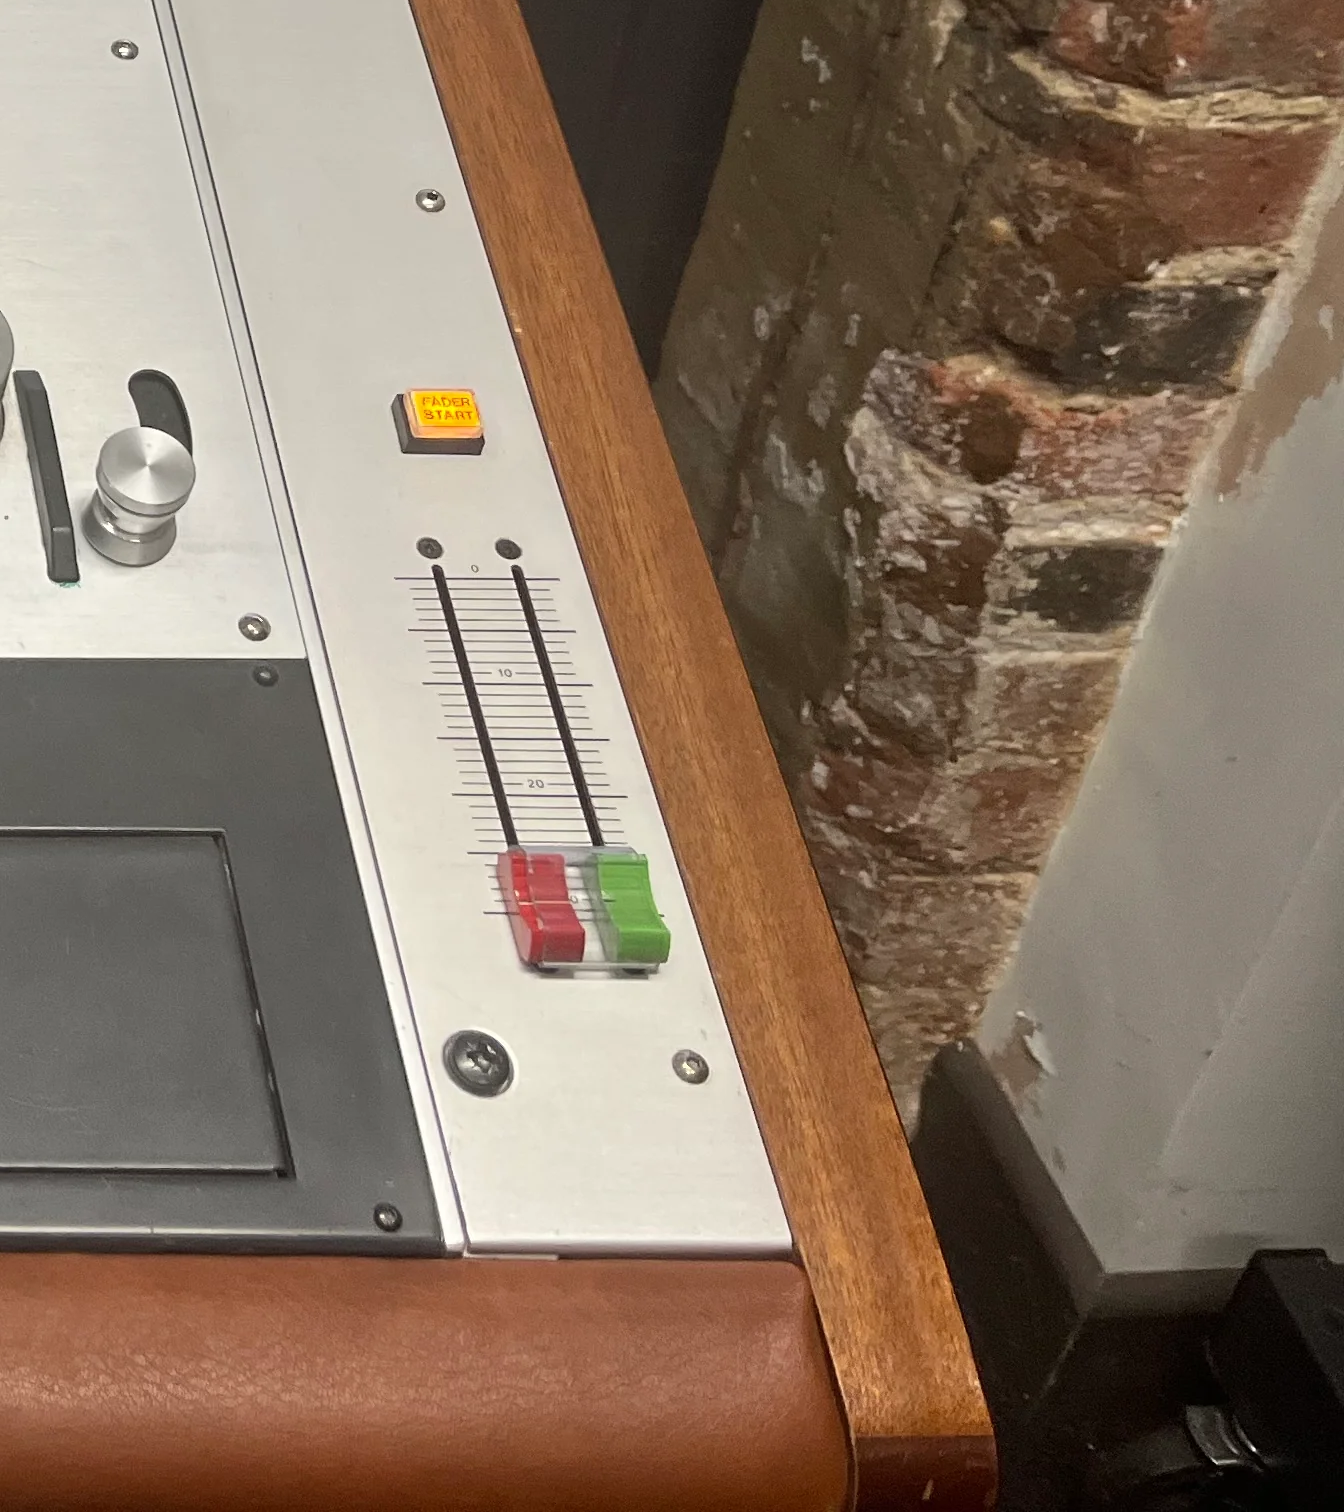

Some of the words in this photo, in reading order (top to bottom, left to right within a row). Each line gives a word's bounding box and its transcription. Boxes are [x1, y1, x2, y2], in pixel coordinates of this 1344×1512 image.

[422, 396, 470, 407] FADER
[423, 410, 473, 420] START
[470, 564, 479, 573] 0
[498, 668, 512, 678] 10
[527, 779, 544, 789] 20
